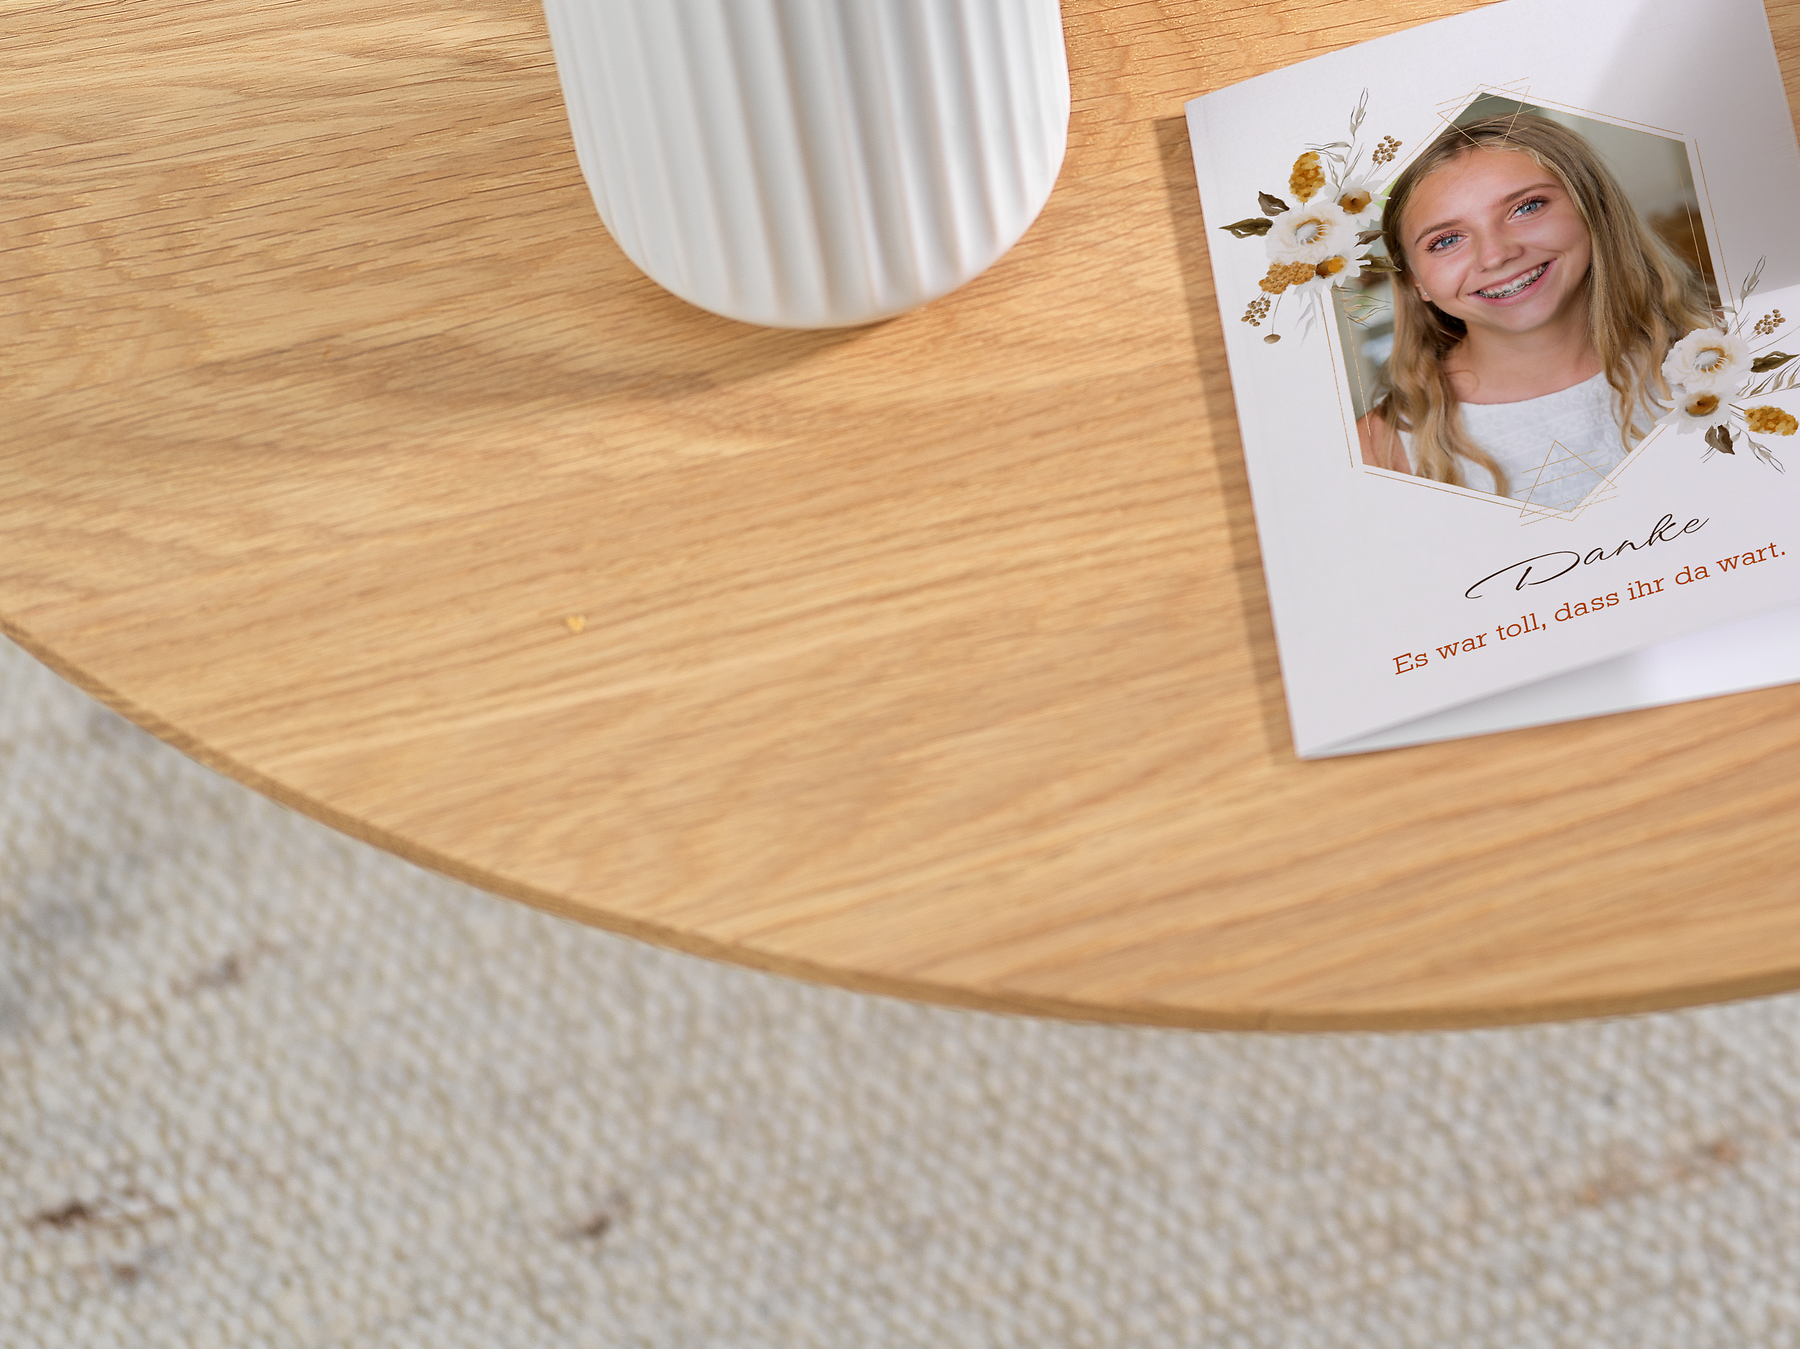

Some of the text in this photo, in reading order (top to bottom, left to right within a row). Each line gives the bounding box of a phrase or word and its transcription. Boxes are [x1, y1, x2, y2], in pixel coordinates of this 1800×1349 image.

[1393, 542, 1786, 675] Es war toll, dass ihr da wart.
[1464, 513, 1709, 599] Danke
